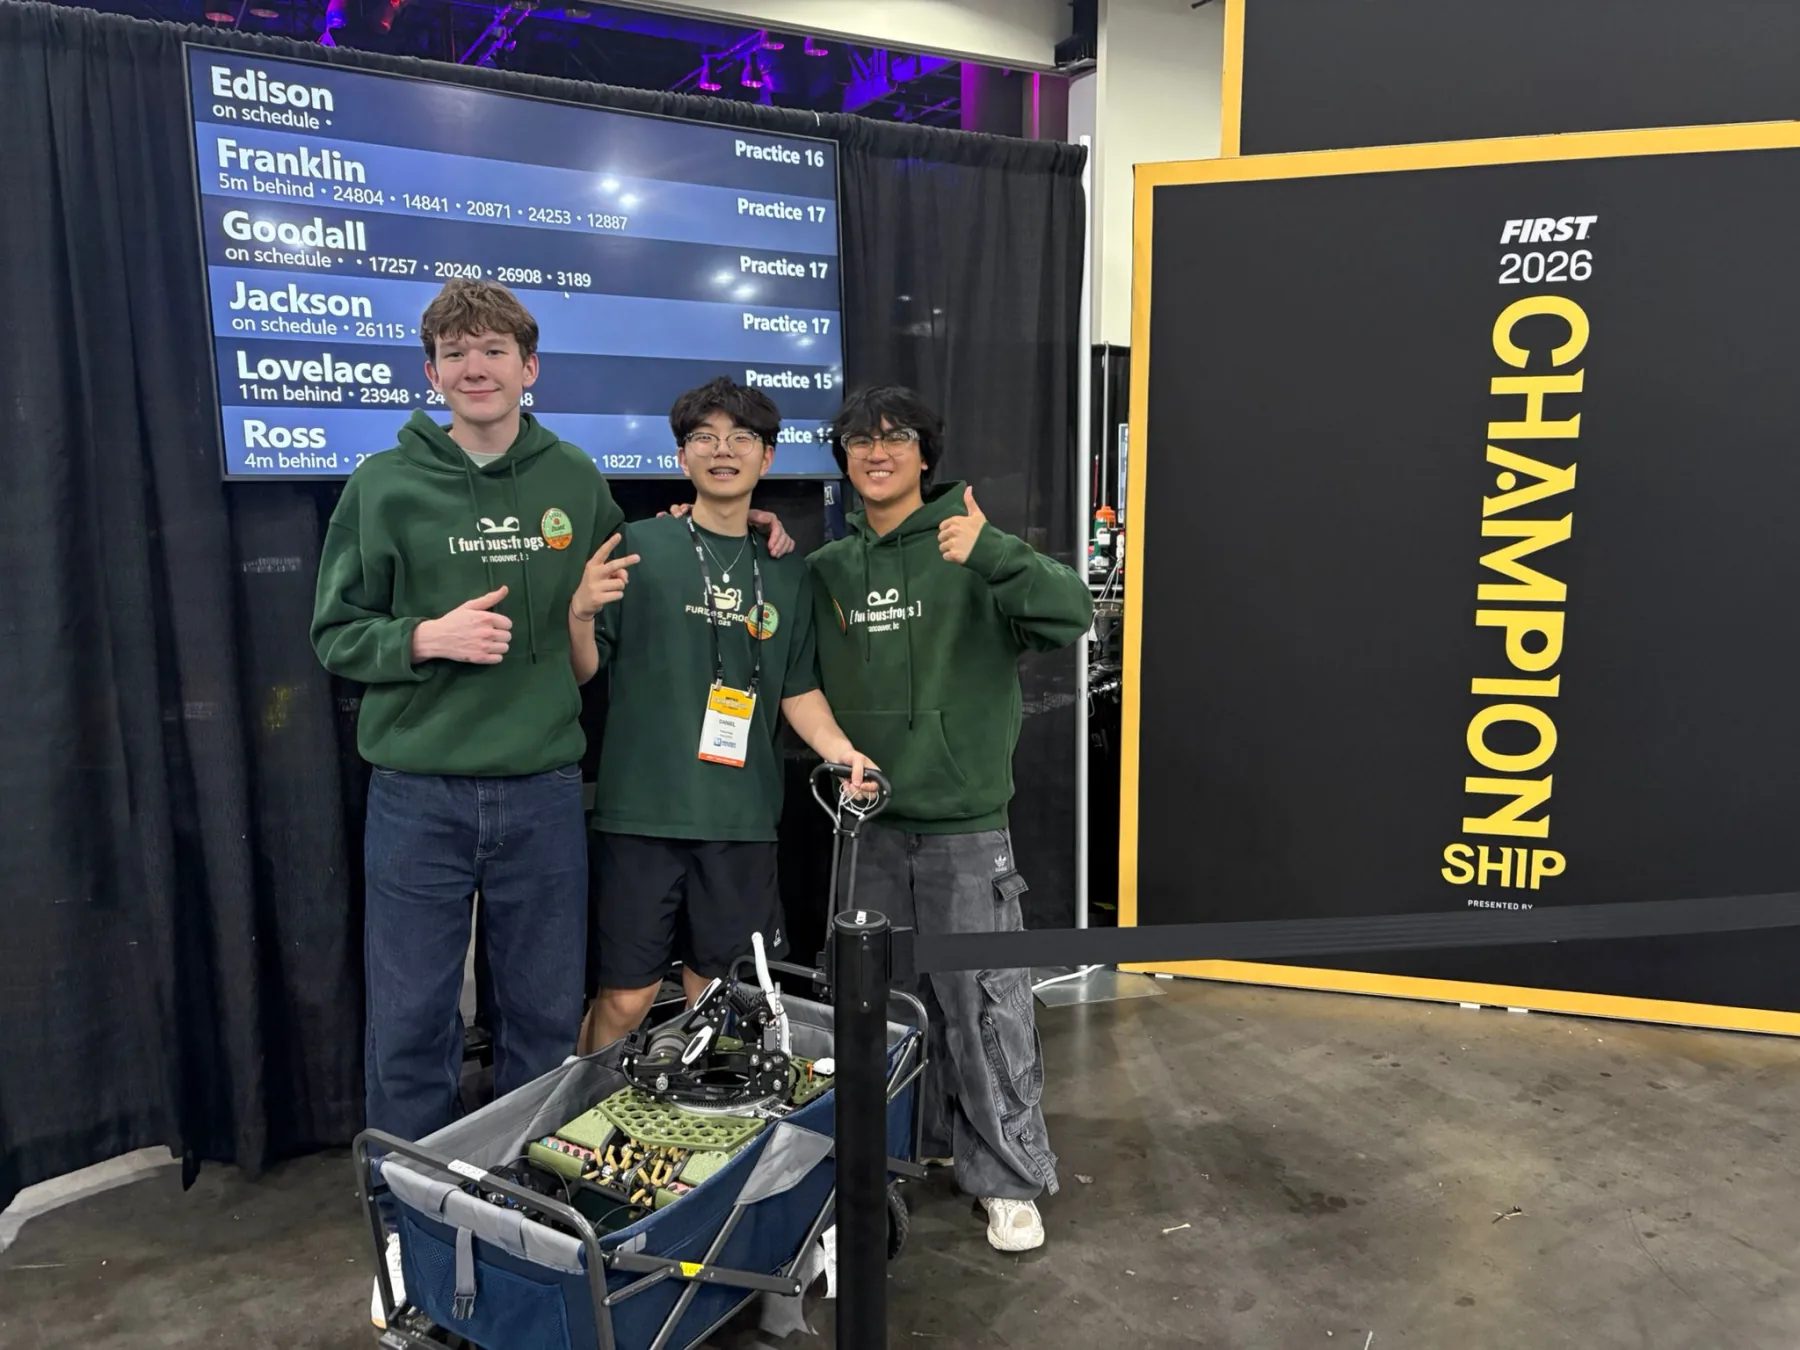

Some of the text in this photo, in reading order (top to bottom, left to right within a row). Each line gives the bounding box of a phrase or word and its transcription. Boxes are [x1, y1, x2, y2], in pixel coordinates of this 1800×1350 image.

[211, 65, 334, 112] Edison
[212, 104, 320, 129] on schedule
[216, 137, 366, 183] Franklin
[735, 139, 824, 168] Practice 16
[218, 173, 628, 231] 5m behind 24804 14841 20871 24253 12887
[737, 197, 826, 223] Practice 17
[222, 210, 367, 251] Goodall
[1500, 215, 1598, 244] FIRST
[225, 247, 592, 287] on schedule 17257 20240 26908 3189
[740, 255, 828, 279] Practice 17
[1498, 250, 1593, 284] 2026
[229, 281, 373, 318] Jackson
[232, 317, 405, 338] on schedule 26115
[743, 313, 830, 335] Practice 17
[236, 350, 392, 384] Lovelace
[746, 370, 832, 390] Practice 15
[239, 384, 278, 401] 11m
[283, 385, 342, 402] behind
[360, 388, 410, 404] 23948
[243, 419, 327, 449] Ross
[776, 426, 812, 444] ctice
[244, 453, 273, 468] 4m
[278, 453, 338, 469] behind
[602, 454, 642, 468] 18227
[657, 455, 679, 469] 161
[1462, 295, 1590, 838] CHAMPION
[1441, 843, 1567, 890] SHIP
[1467, 899, 1519, 910] PRESENTED
